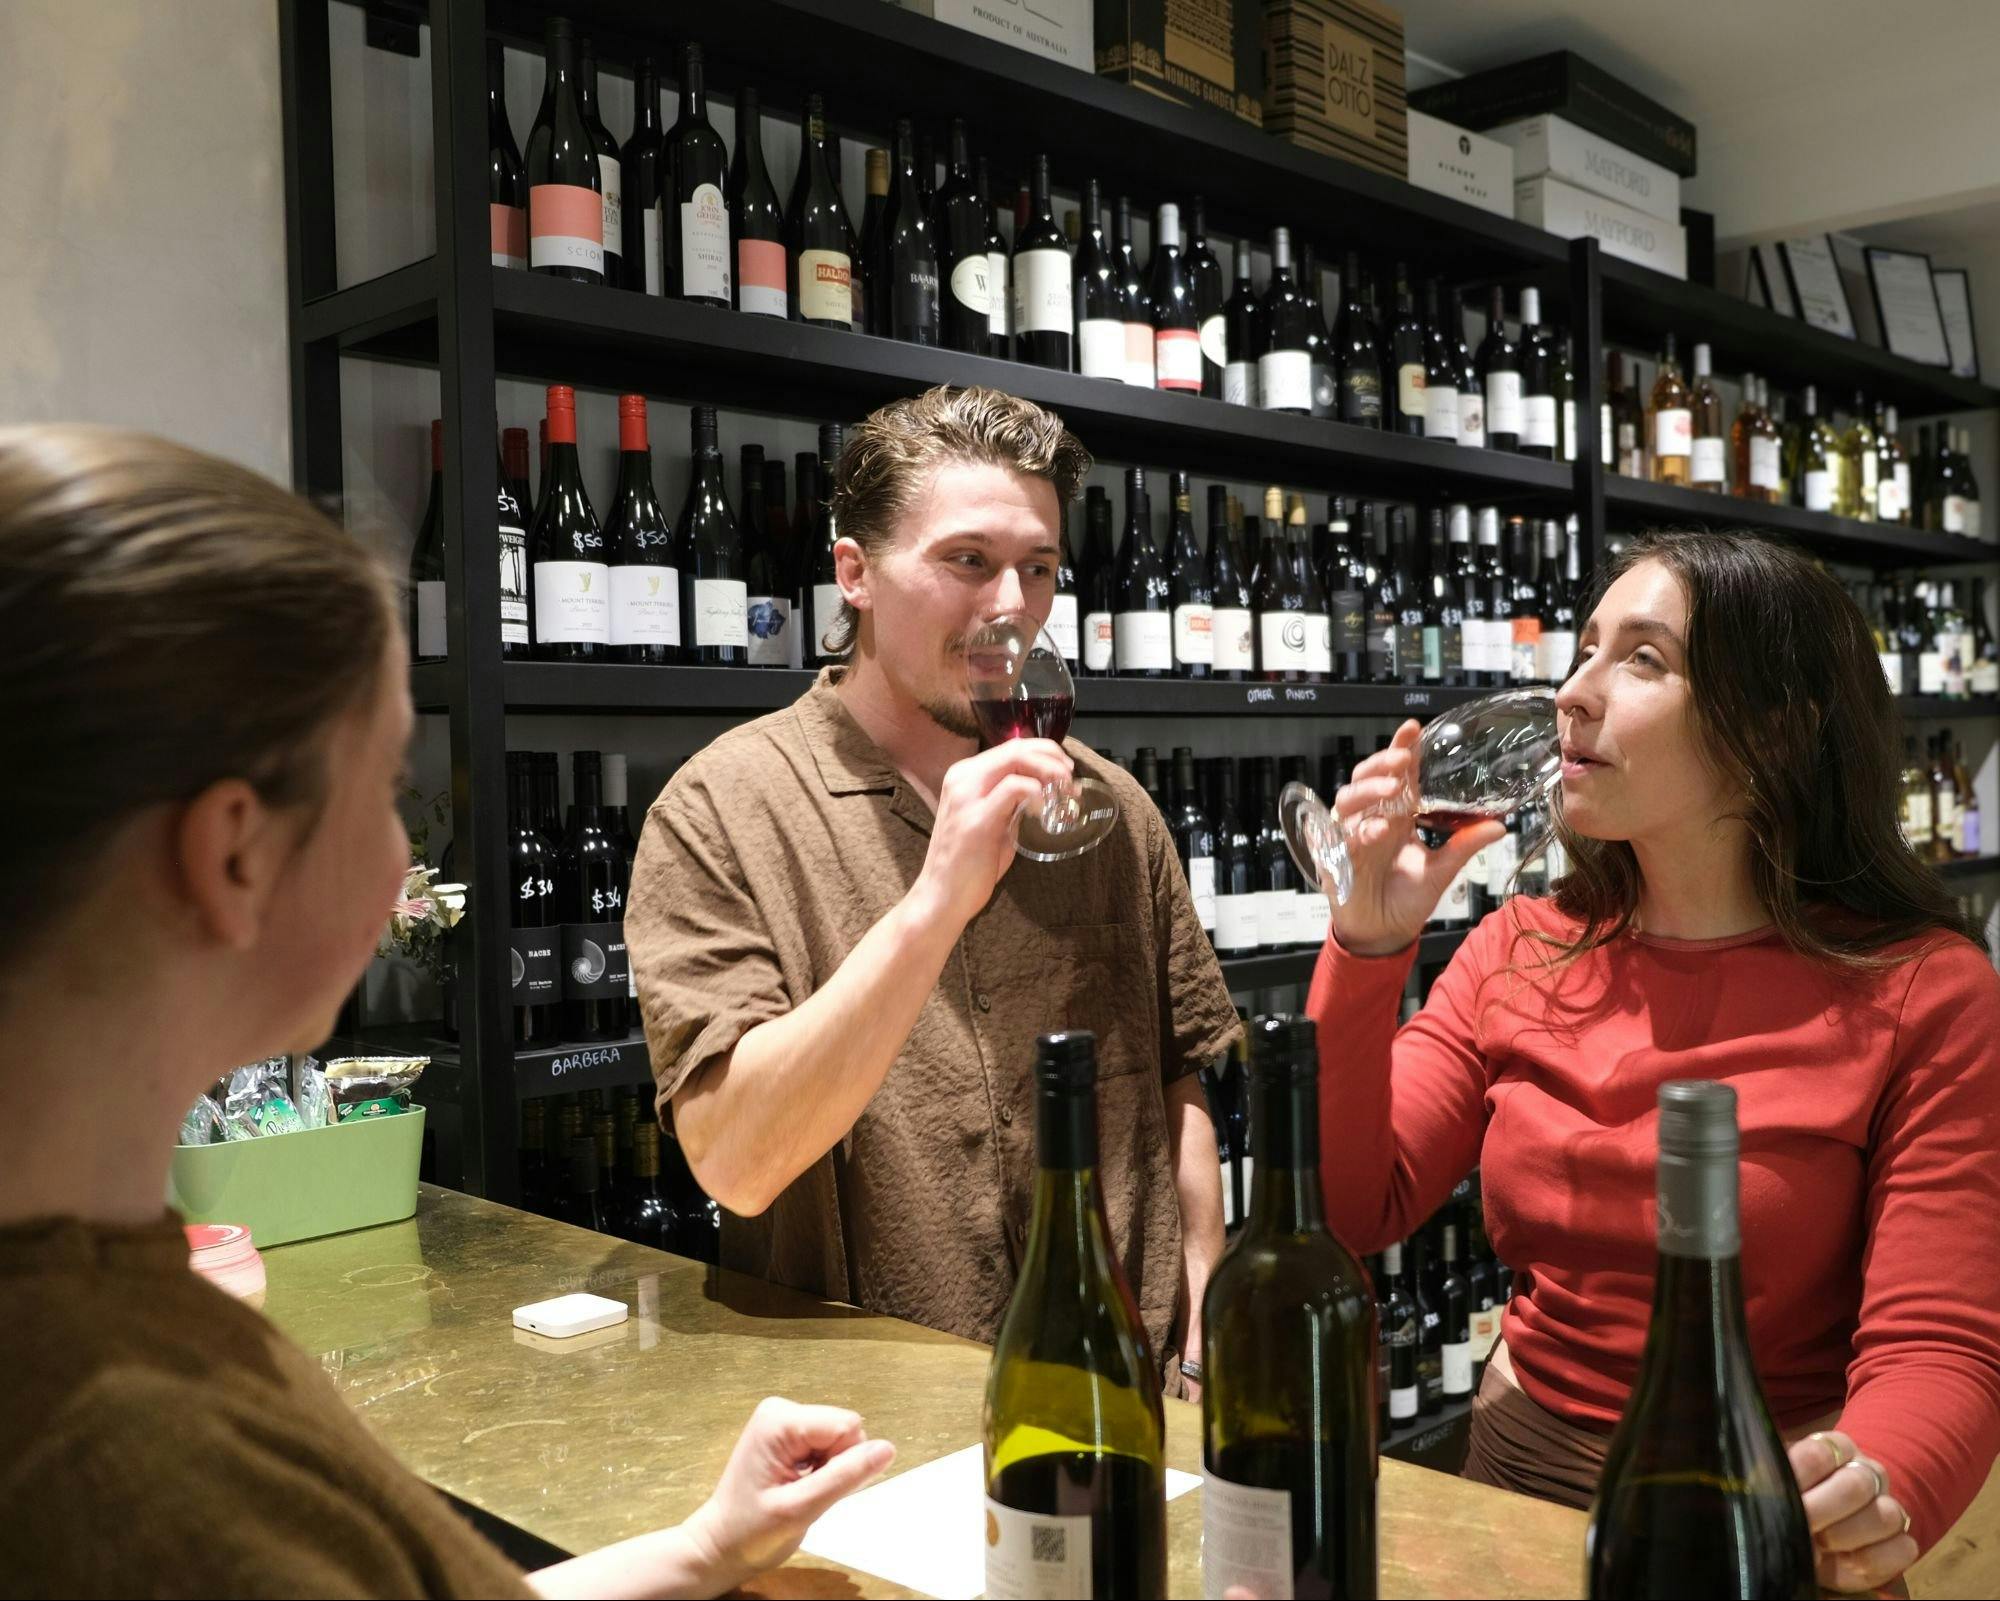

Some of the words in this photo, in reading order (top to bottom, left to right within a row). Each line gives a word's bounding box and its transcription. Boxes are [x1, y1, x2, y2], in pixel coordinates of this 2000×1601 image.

[973, 6, 1010, 29] PRODUCT
[1013, 25, 1022, 35] OF
[1025, 31, 1068, 55] AUSTRALIA
[1329, 42, 1368, 87] DALZ
[1328, 76, 1371, 117] OTTO
[1584, 209, 1656, 252] MAYFORD
[572, 529, 604, 554] $50
[635, 528, 668, 550] $50
[1247, 687, 1275, 704] OTHER
[1285, 687, 1317, 701] PINOTS
[591, 885, 622, 914] $34
[551, 1046, 621, 1076] BARBERA
